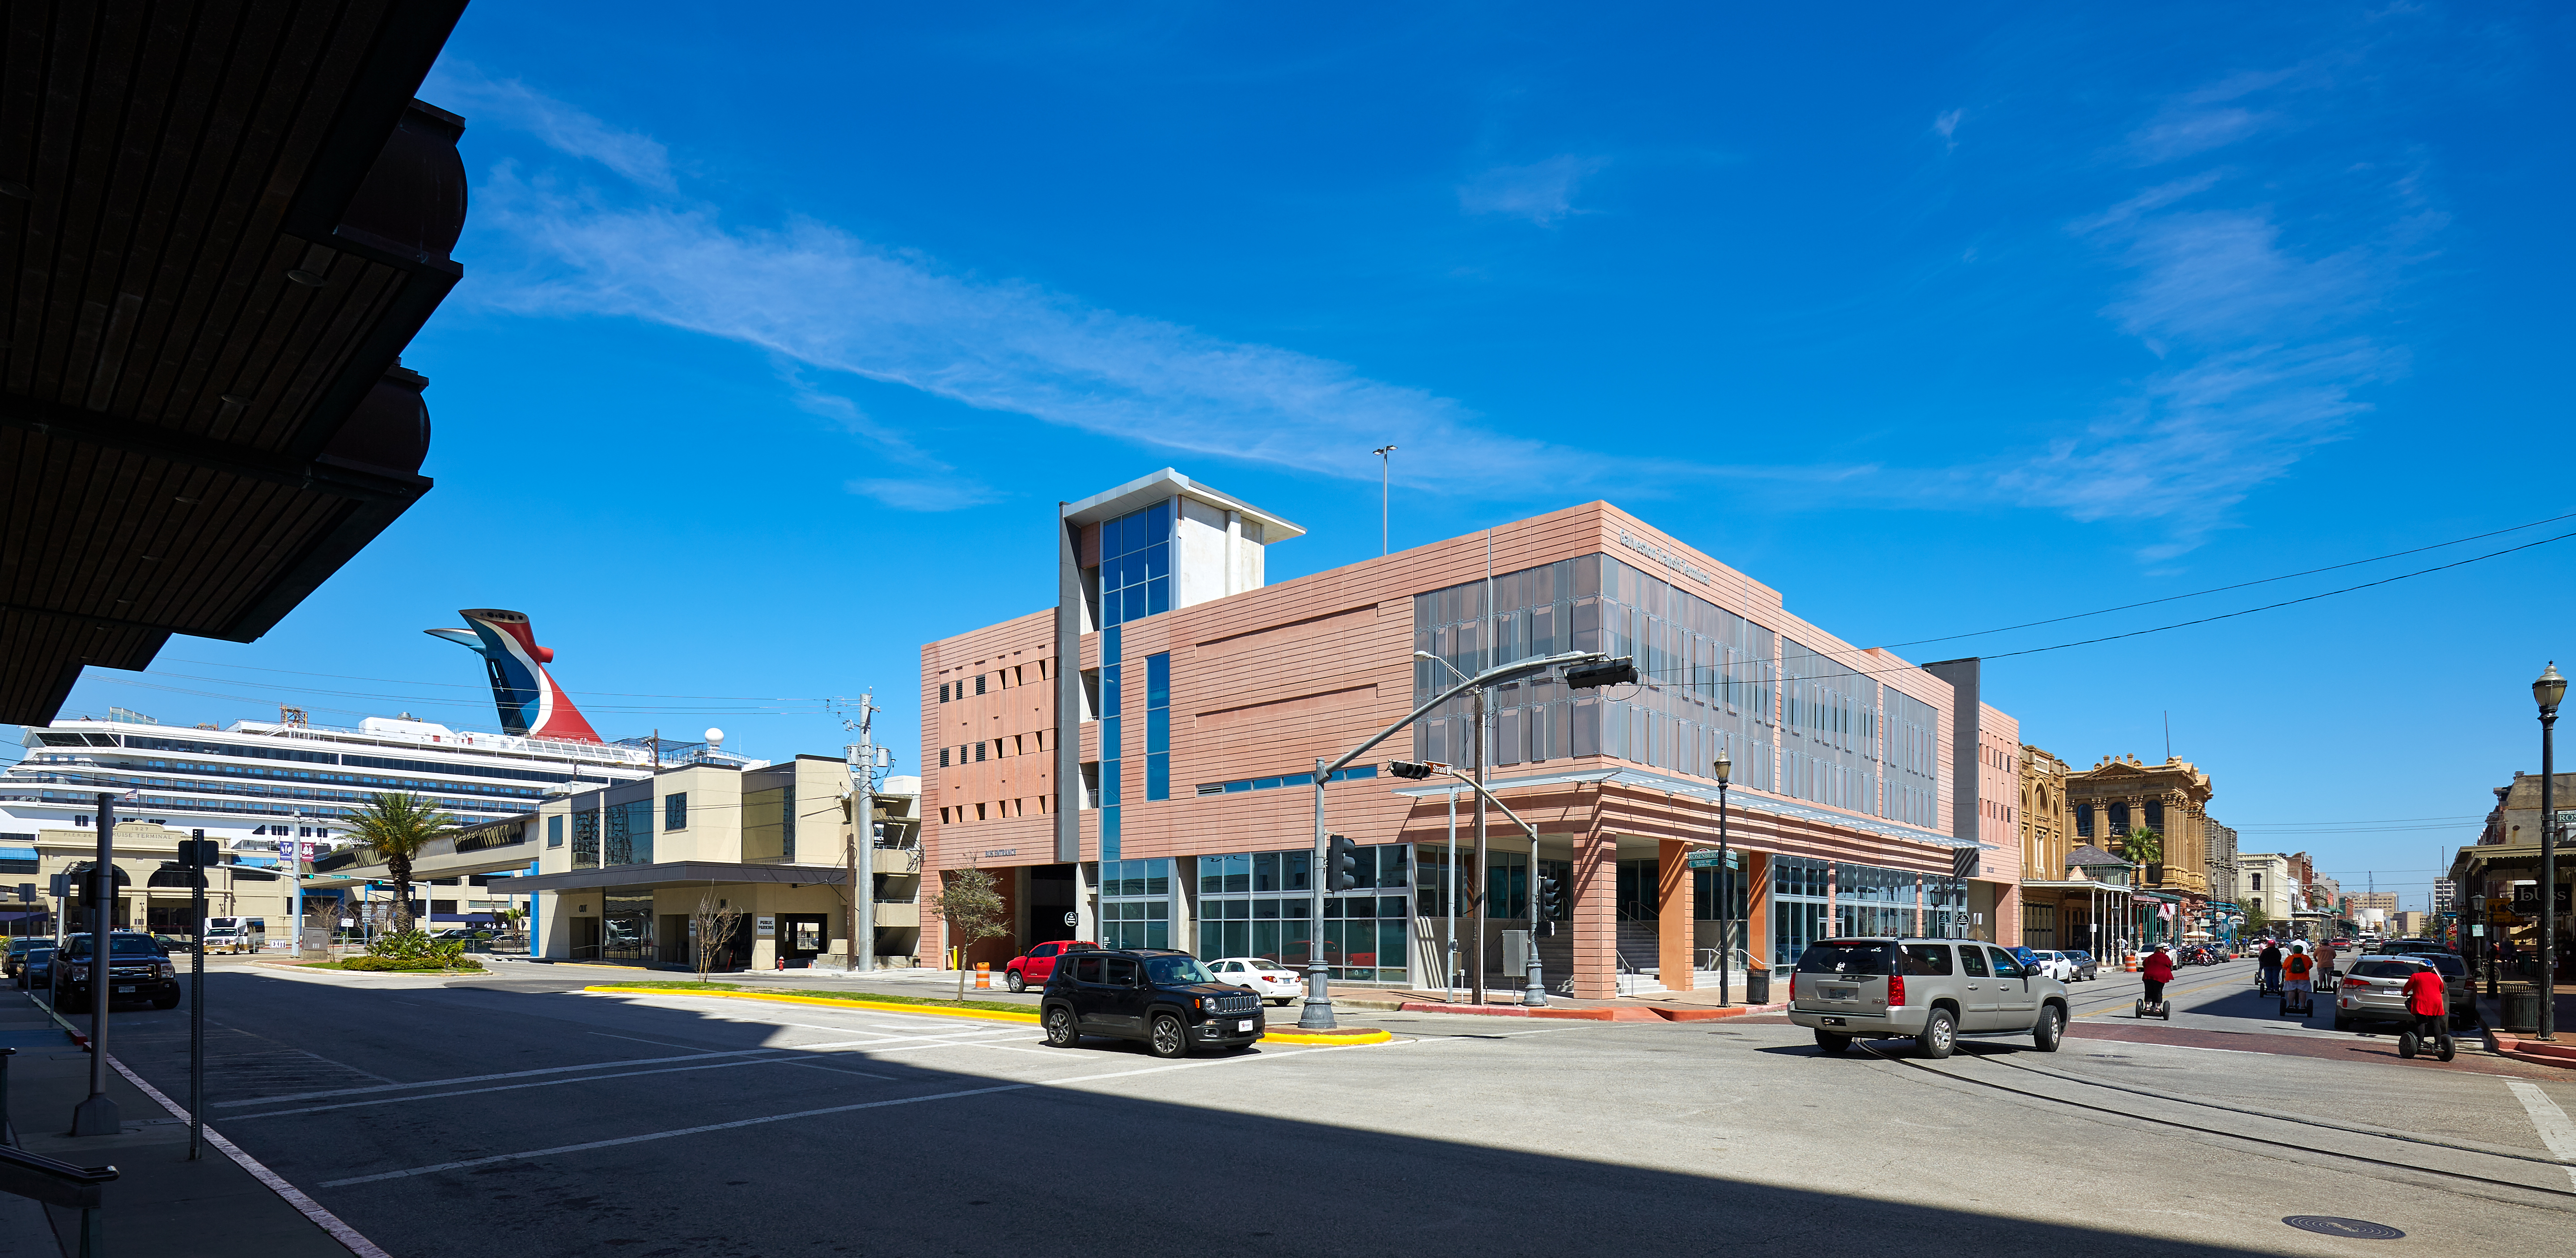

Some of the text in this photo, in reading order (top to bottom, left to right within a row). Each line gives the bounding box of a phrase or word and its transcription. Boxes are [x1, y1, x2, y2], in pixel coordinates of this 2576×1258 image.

[1619, 528, 1710, 586] Galveston Transit Terminal
[1432, 764, 1446, 773] Strand
[995, 849, 1016, 857] ENTRANCE
[2519, 887, 2567, 901] bls
